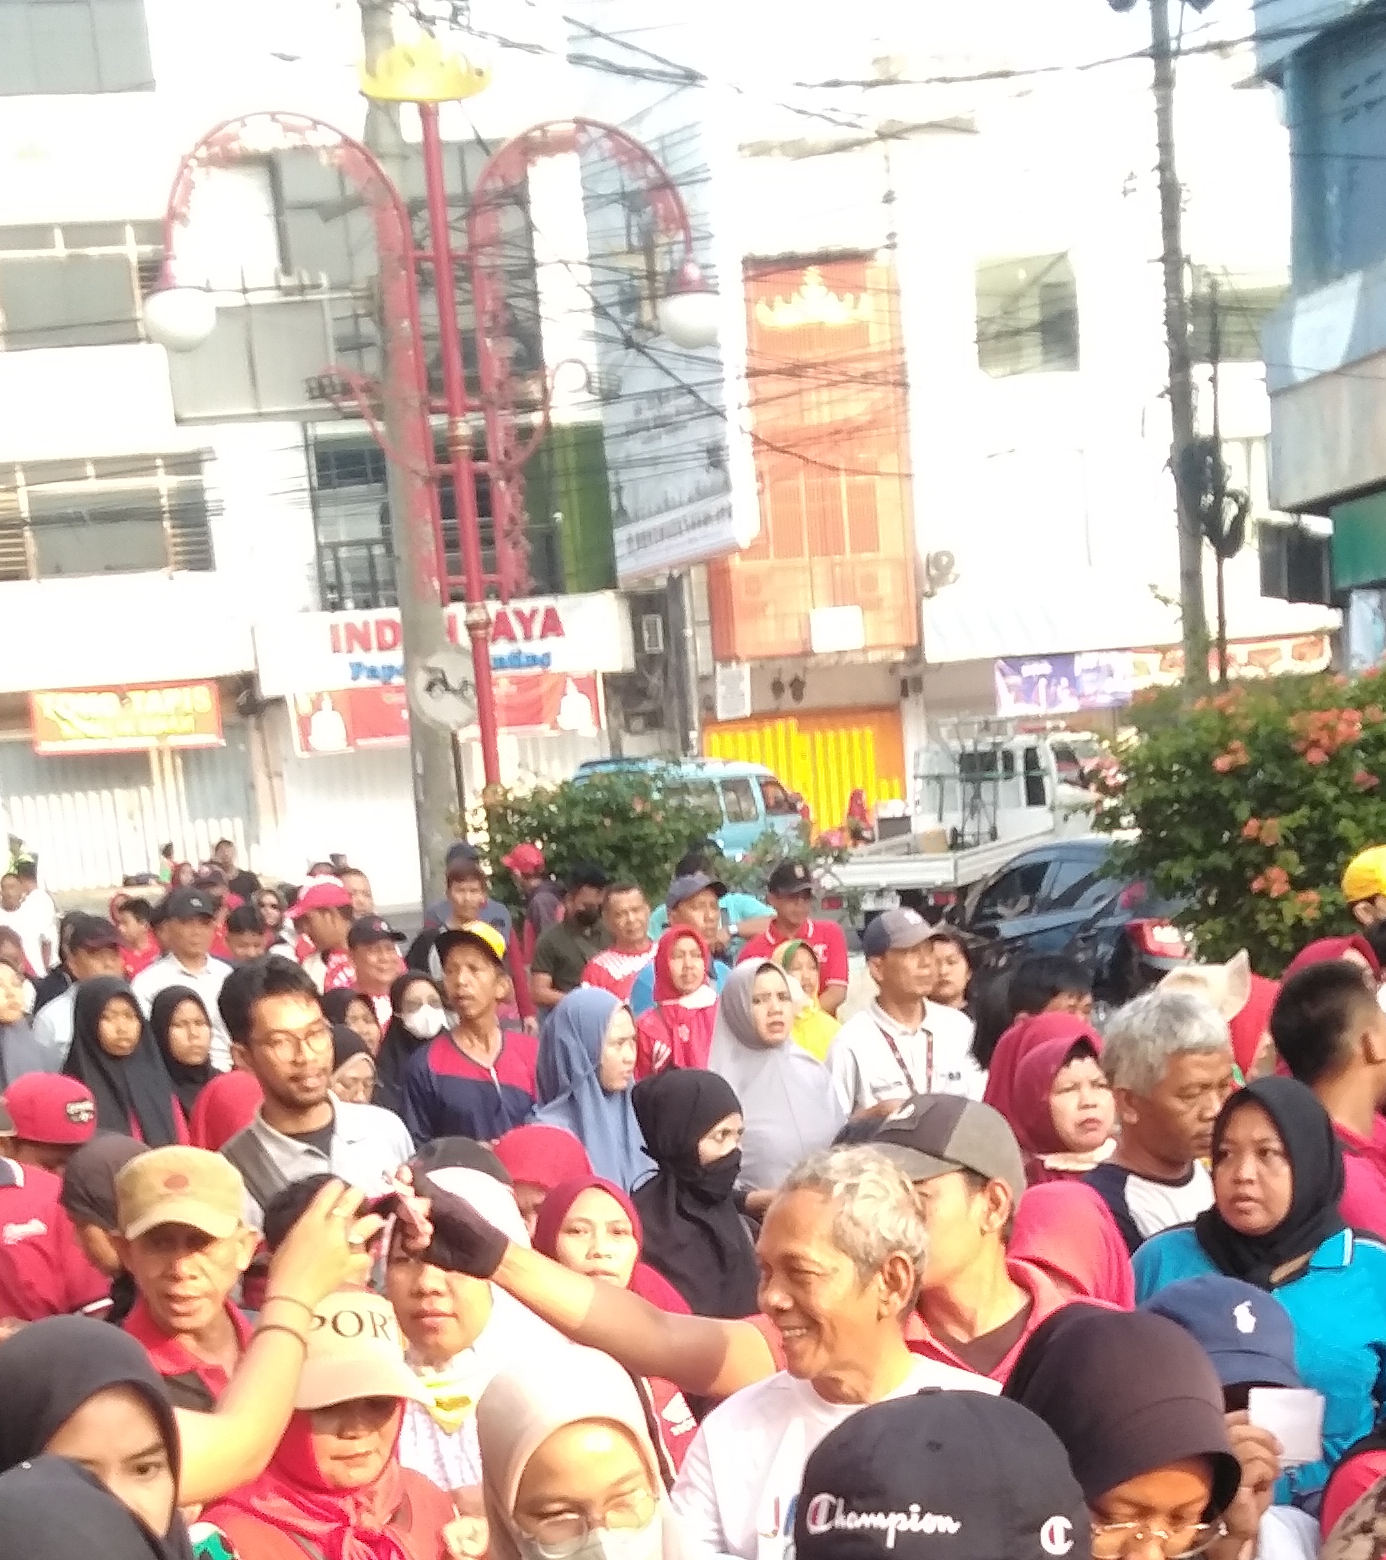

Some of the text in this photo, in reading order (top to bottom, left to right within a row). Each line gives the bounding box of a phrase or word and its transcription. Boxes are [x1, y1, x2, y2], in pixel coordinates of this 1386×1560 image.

[330, 605, 566, 654] IND AYA
[806, 1492, 962, 1550] Champion
